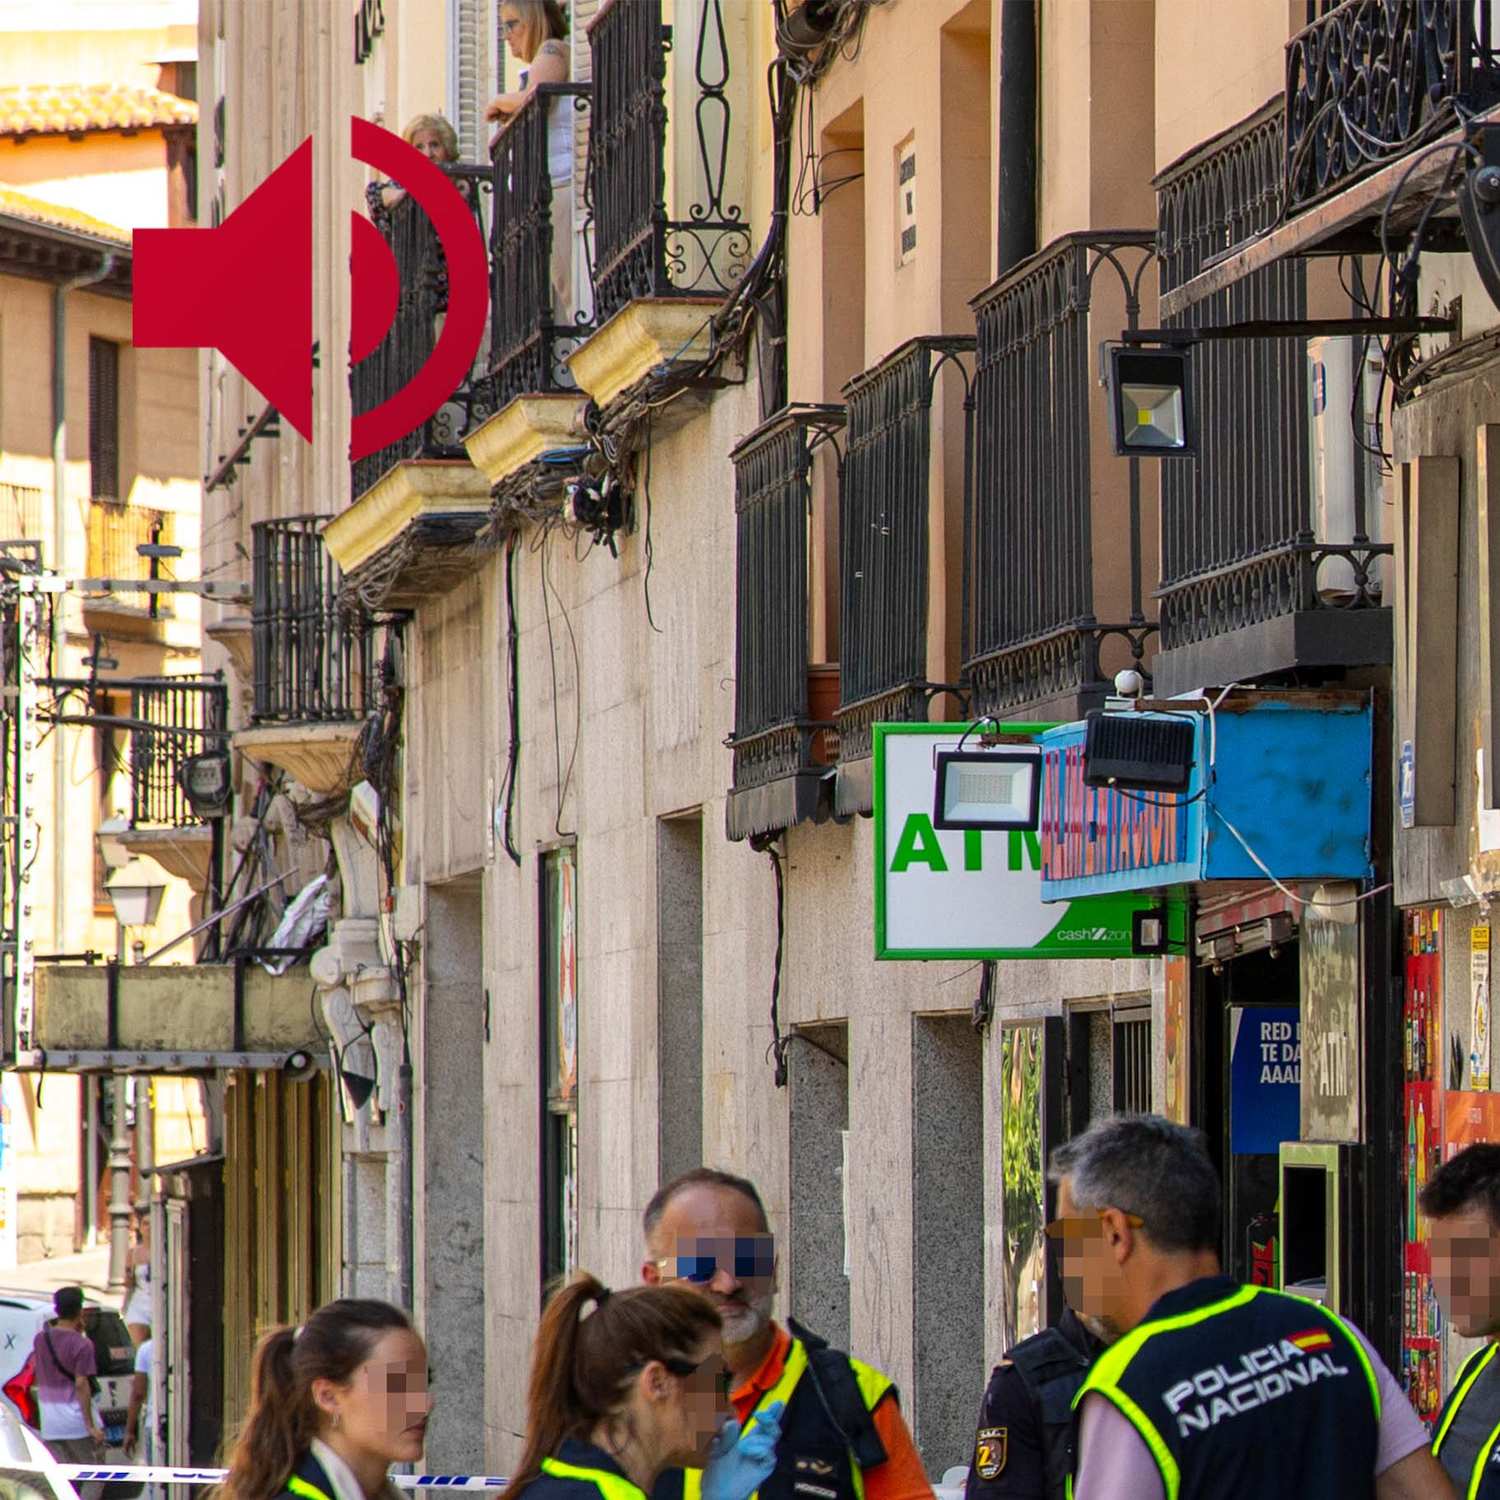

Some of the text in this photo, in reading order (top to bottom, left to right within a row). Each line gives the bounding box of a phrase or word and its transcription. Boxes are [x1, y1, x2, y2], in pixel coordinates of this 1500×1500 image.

[1260, 1022, 1292, 1041] RED
[1260, 1044, 1279, 1062] TE
[1320, 1030, 1347, 1096] ATM
[1177, 1353, 1348, 1438] NACIONAL
